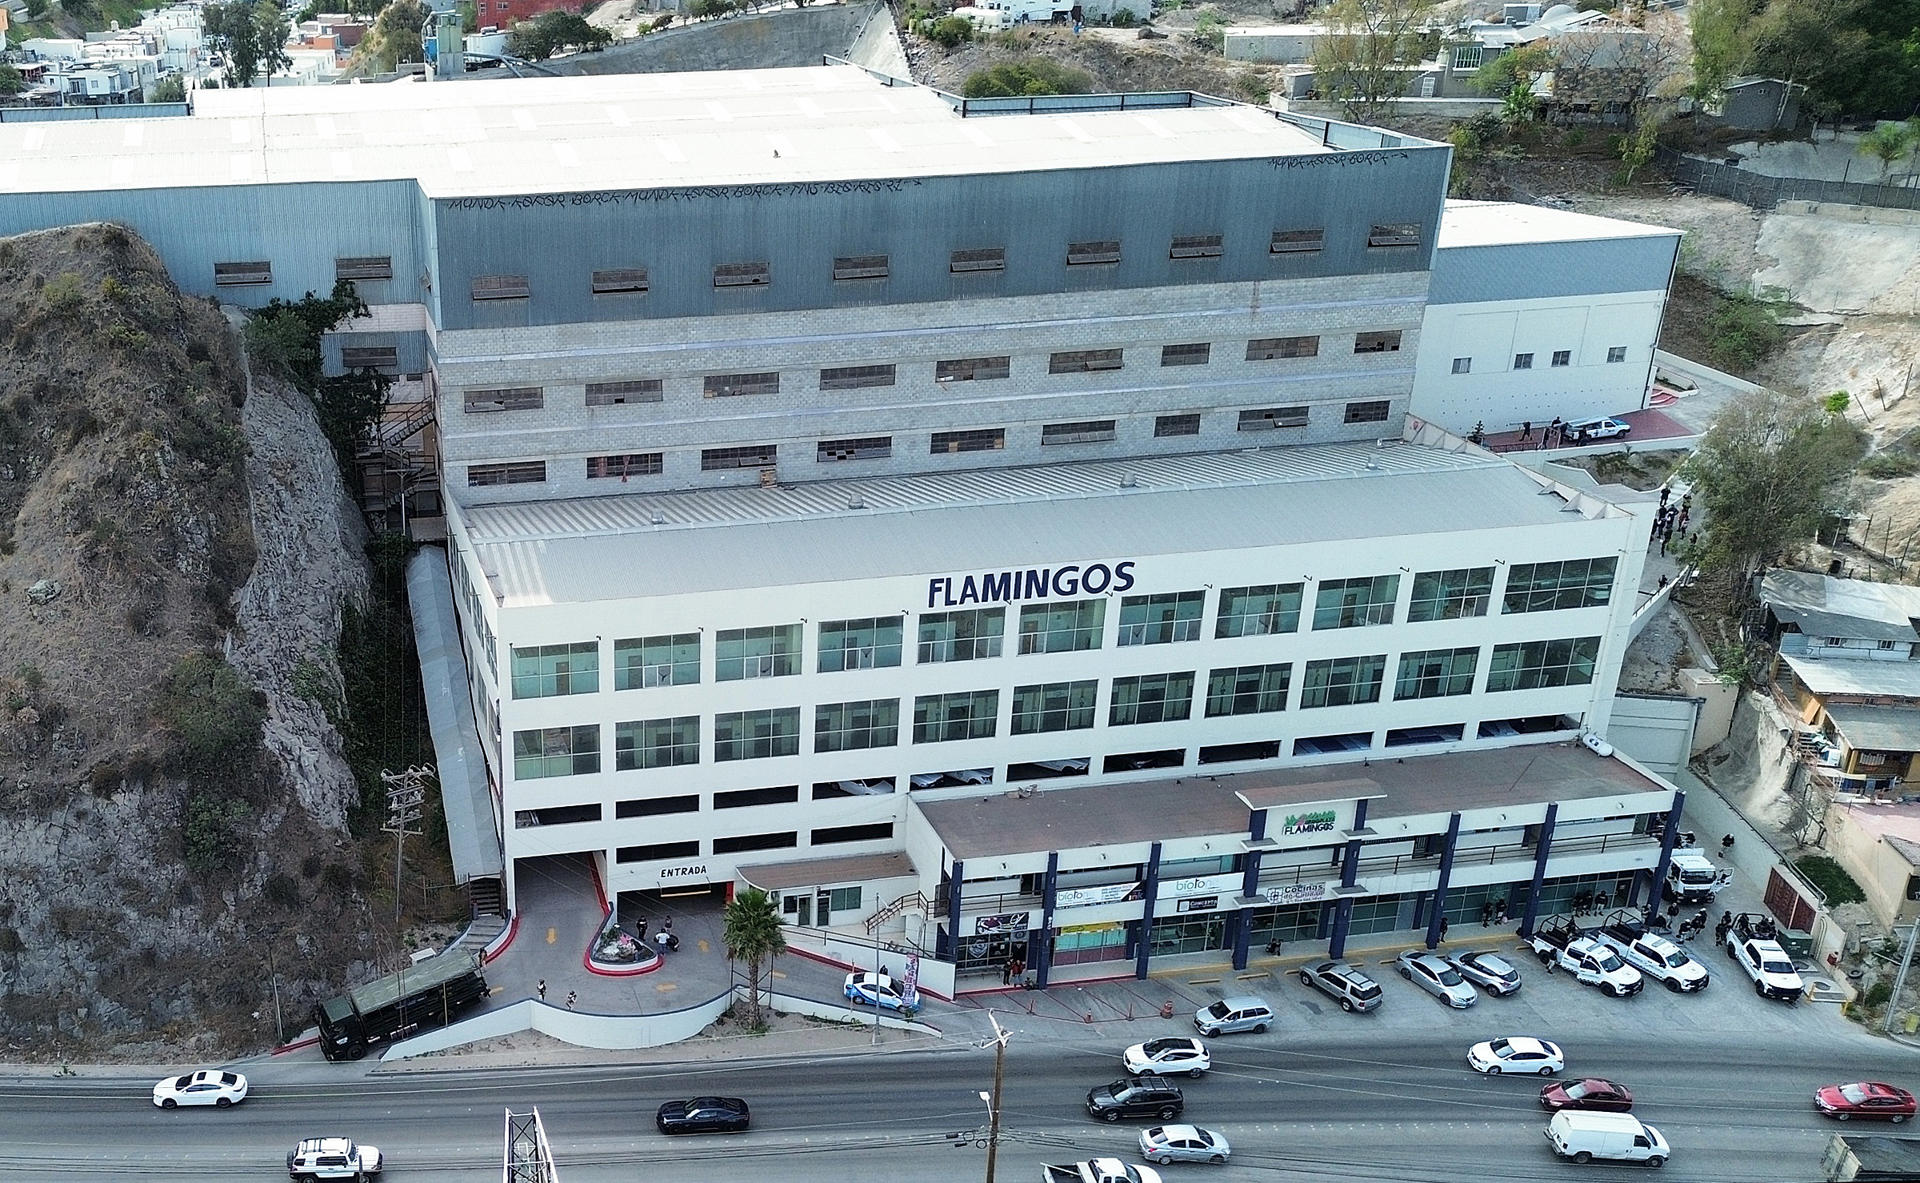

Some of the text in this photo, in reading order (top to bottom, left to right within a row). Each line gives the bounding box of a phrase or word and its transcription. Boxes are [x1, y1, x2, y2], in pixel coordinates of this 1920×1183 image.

[928, 561, 1136, 608] FLAMINGOS
[1283, 823, 1334, 835] FLAMINGOS
[660, 865, 707, 878] ENTRADA
[1284, 884, 1323, 894] Cocinas
